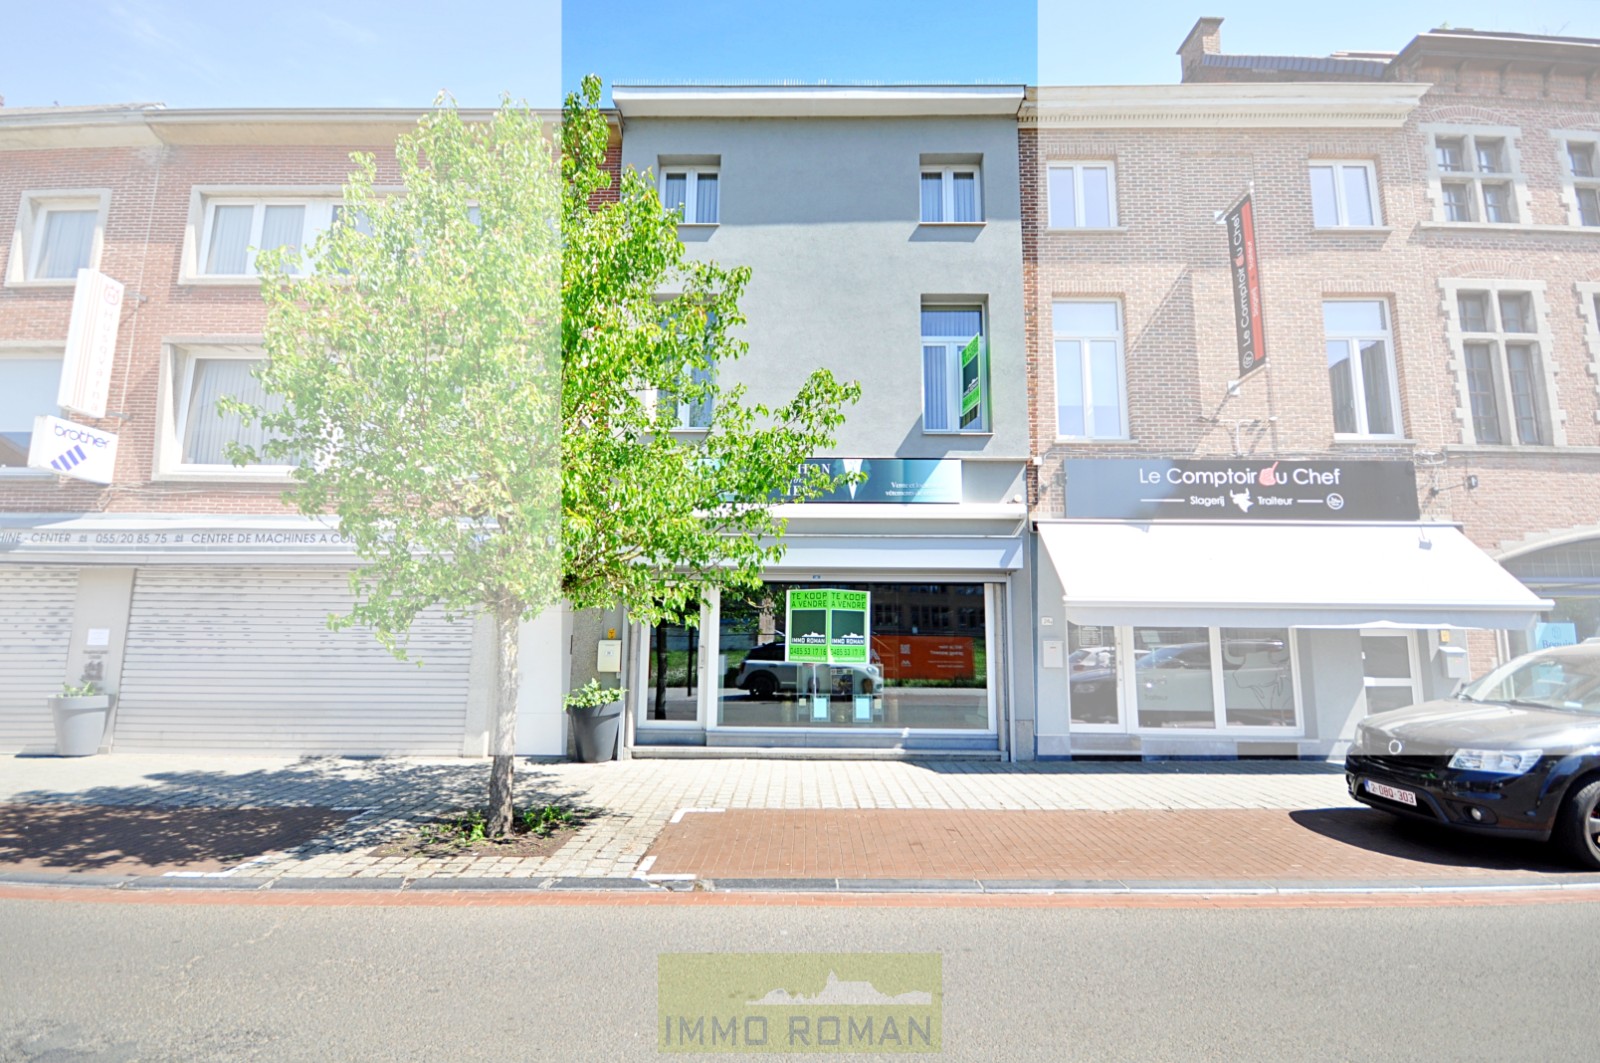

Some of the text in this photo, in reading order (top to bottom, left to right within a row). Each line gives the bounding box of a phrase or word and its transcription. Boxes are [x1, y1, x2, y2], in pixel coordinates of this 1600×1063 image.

[1237, 268, 1249, 328] Comptoir
[54, 423, 110, 448] brother
[1139, 468, 1161, 484] Le
[1166, 467, 1257, 488] Comptoir
[1291, 468, 1341, 485] Chef
[1189, 495, 1293, 507] Slagerij Traiteur
[31, 532, 71, 543] CENTER
[95, 533, 134, 543] 055/20
[136, 533, 150, 543] 85
[154, 533, 167, 543] 75
[190, 533, 237, 544] CENTRE
[237, 533, 252, 544] DE
[254, 533, 315, 544] MACHINES
[318, 533, 329, 544] A
[791, 592, 827, 600] TE KOOP
[831, 592, 866, 601] TE KOOP
[798, 600, 827, 608] VENDRE
